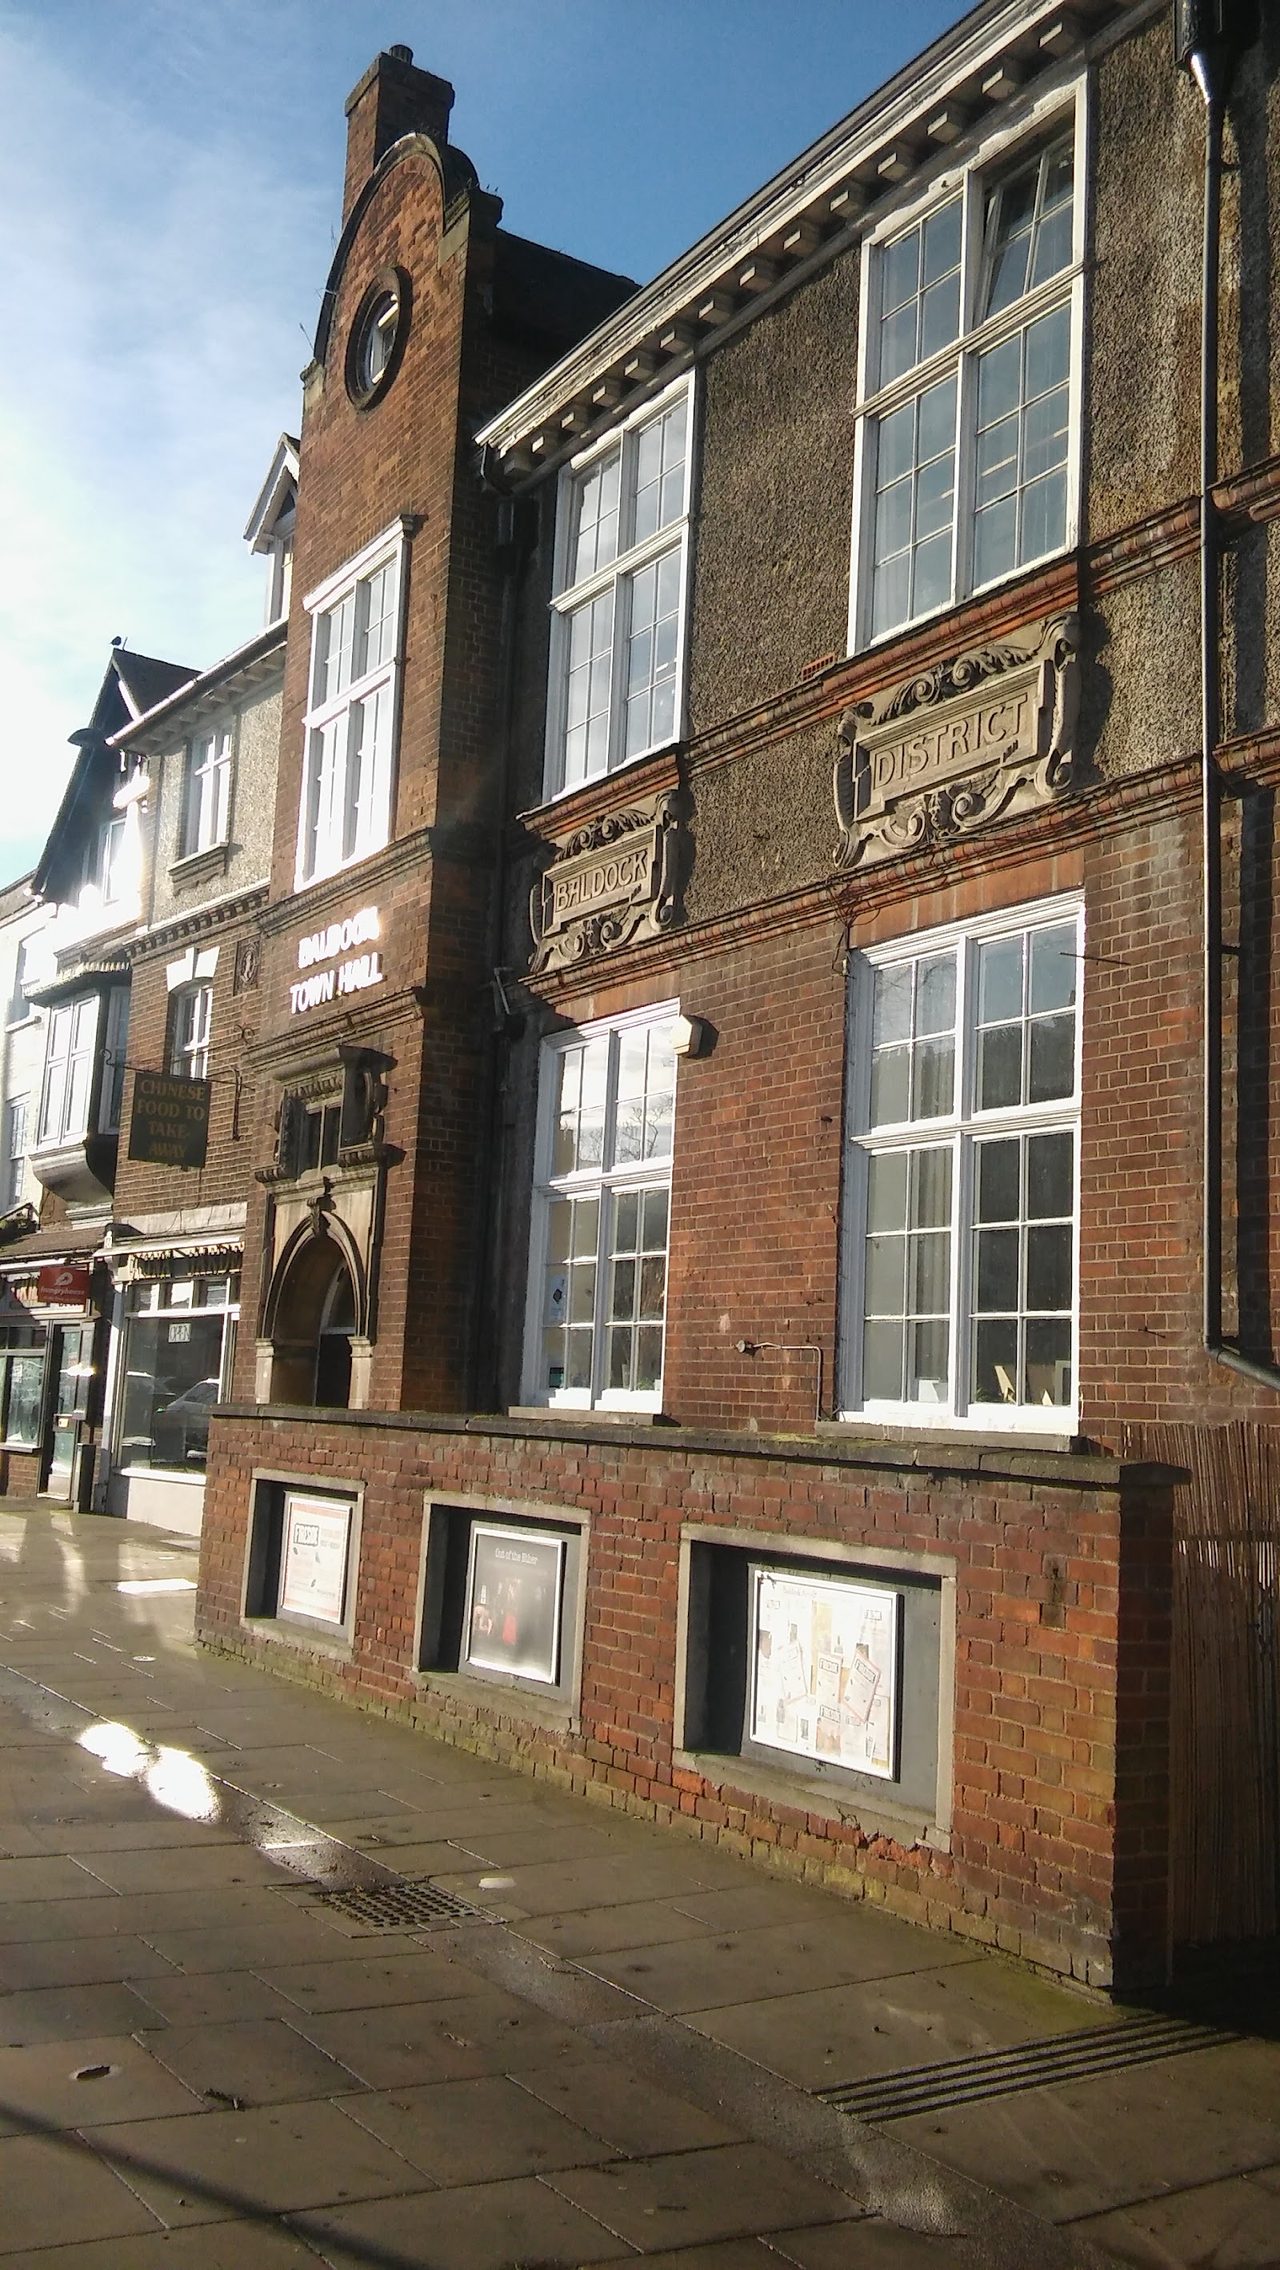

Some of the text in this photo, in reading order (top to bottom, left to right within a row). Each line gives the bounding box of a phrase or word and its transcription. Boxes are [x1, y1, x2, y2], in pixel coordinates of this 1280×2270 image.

[872, 691, 1029, 791] DISTRICT
[555, 848, 649, 913] BALDOCK
[289, 951, 383, 1014] TOWN HALL
[136, 1099, 206, 1121] FOOD TO
[141, 1079, 206, 1101] CHINESE
